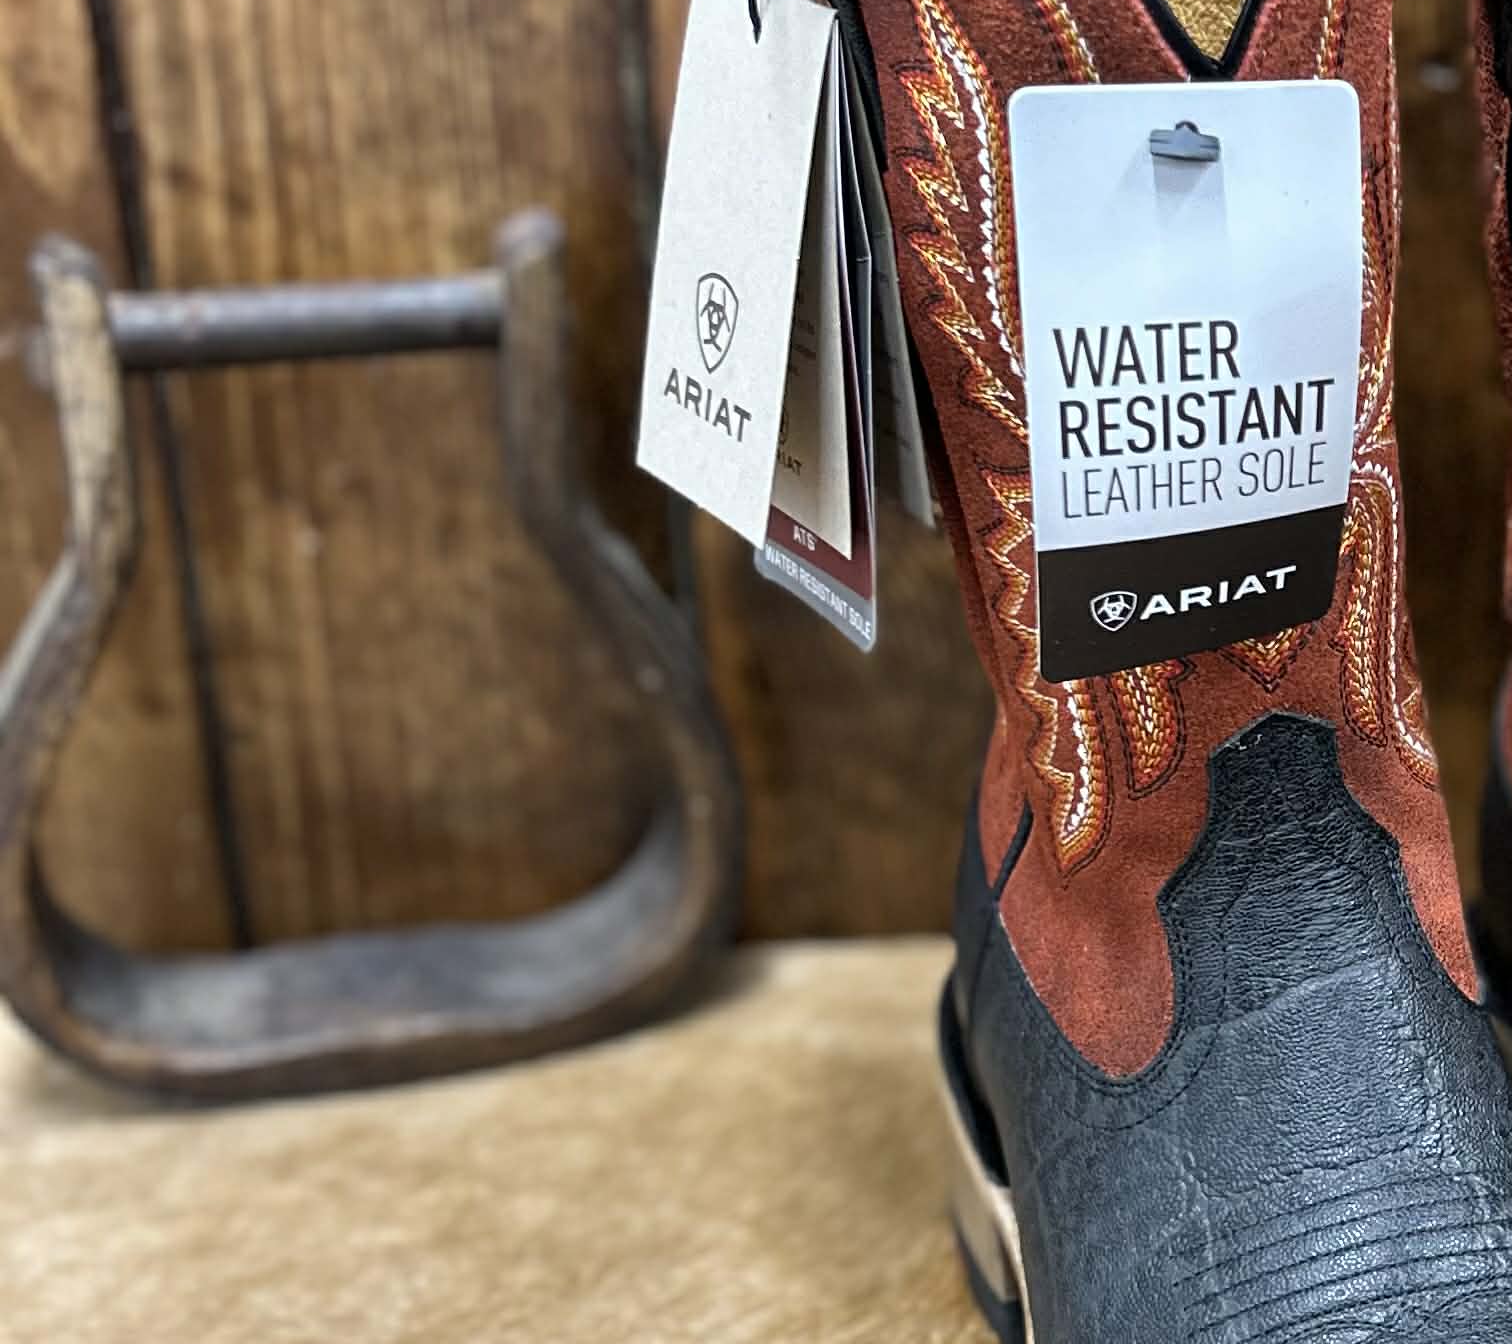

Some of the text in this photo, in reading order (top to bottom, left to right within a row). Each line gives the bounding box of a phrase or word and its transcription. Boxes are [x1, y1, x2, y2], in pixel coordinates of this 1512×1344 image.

[1053, 320, 1240, 389] WATER
[664, 368, 752, 442] ARIAT
[1058, 378, 1335, 458] RESISTANT
[1061, 441, 1328, 520] LEATHER SOLE
[765, 543, 872, 641] WATER RESISTANT SOLE
[1139, 564, 1297, 621] ARIAT
